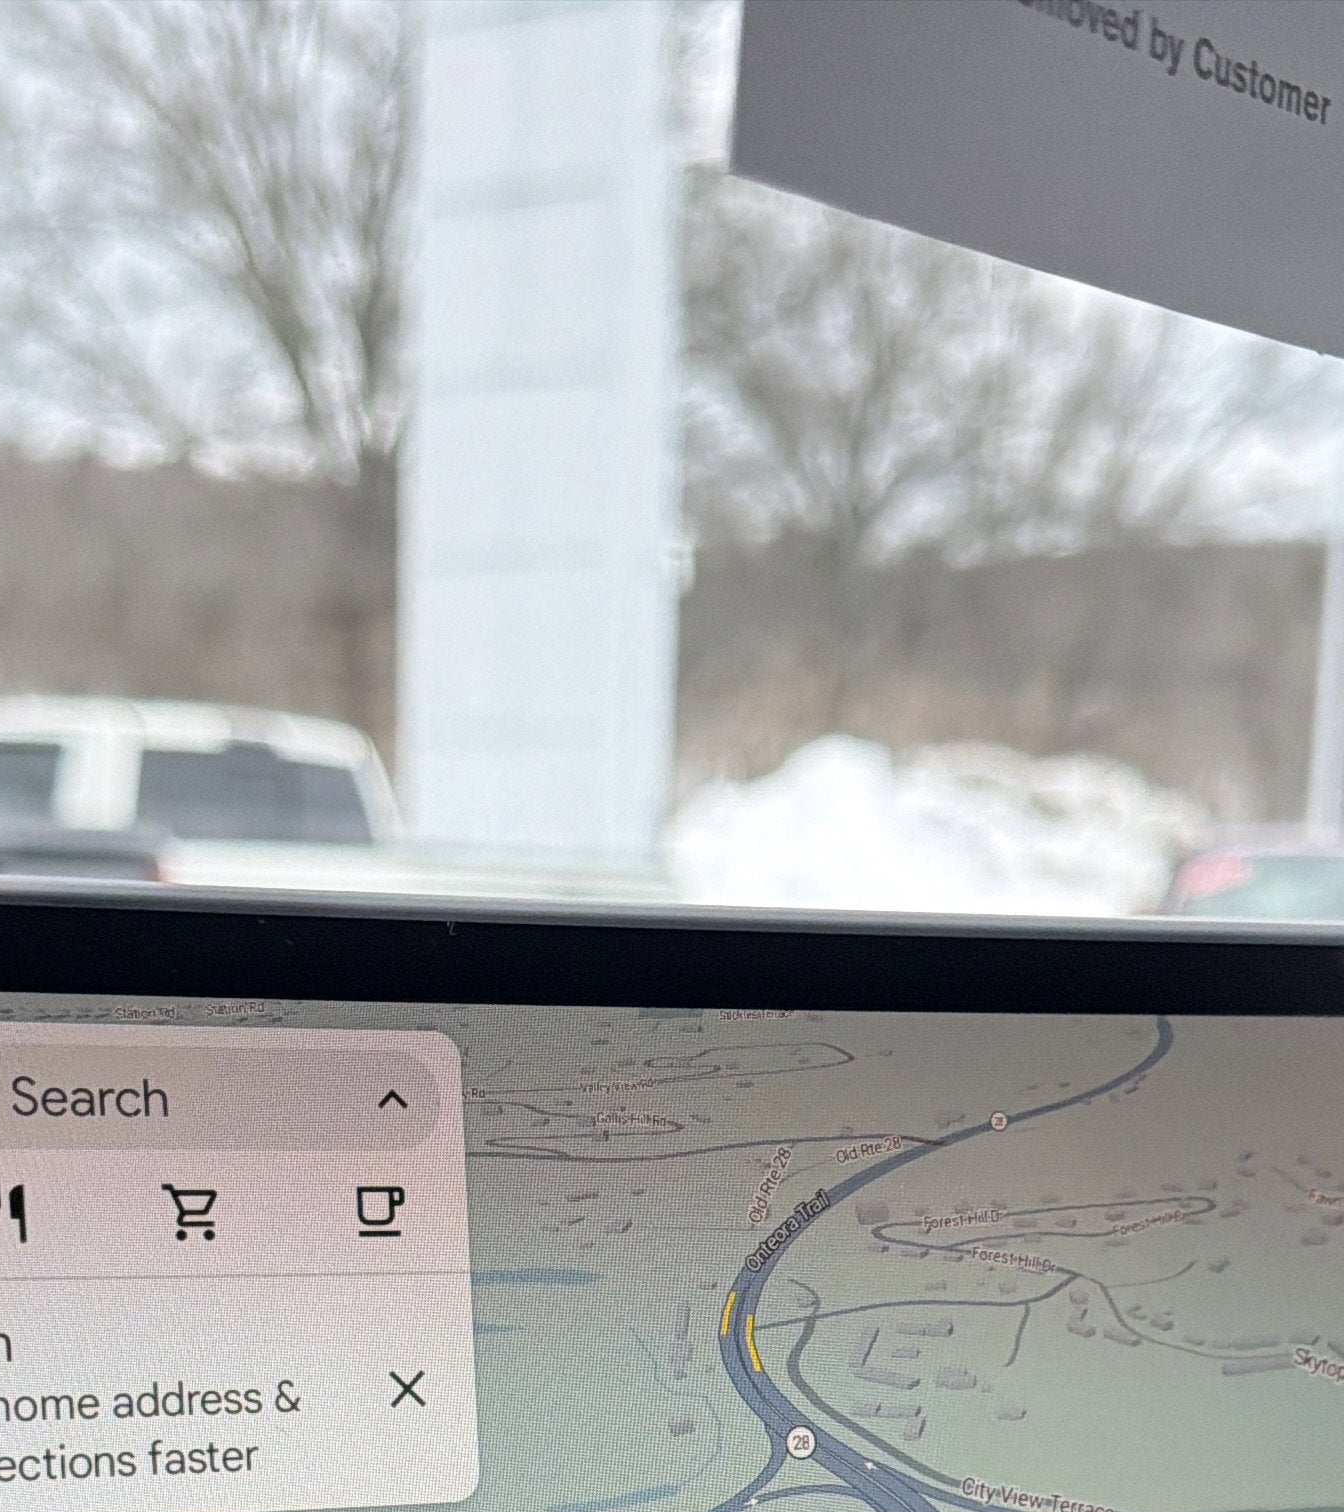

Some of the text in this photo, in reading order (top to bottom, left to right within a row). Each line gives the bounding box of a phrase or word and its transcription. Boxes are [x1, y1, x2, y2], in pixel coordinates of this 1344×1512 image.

[1016, 0, 1332, 125] moved by Customer
[12, 1075, 169, 1117] Search
[836, 1136, 902, 1164] Old Rte 28
[748, 1147, 792, 1223] Old Rte 28
[746, 1189, 830, 1272] Onteora Trail
[923, 1214, 963, 1229] Forest
[967, 1211, 988, 1225] Hill
[972, 1247, 1015, 1265] Forest
[1018, 1255, 1040, 1270] Hill
[112, 1380, 263, 1419] address
[274, 1379, 302, 1414] &
[148, 1439, 260, 1476] faster
[792, 1434, 810, 1451] 28
[961, 1477, 996, 1504] City
[1001, 1485, 1044, 1509] View
